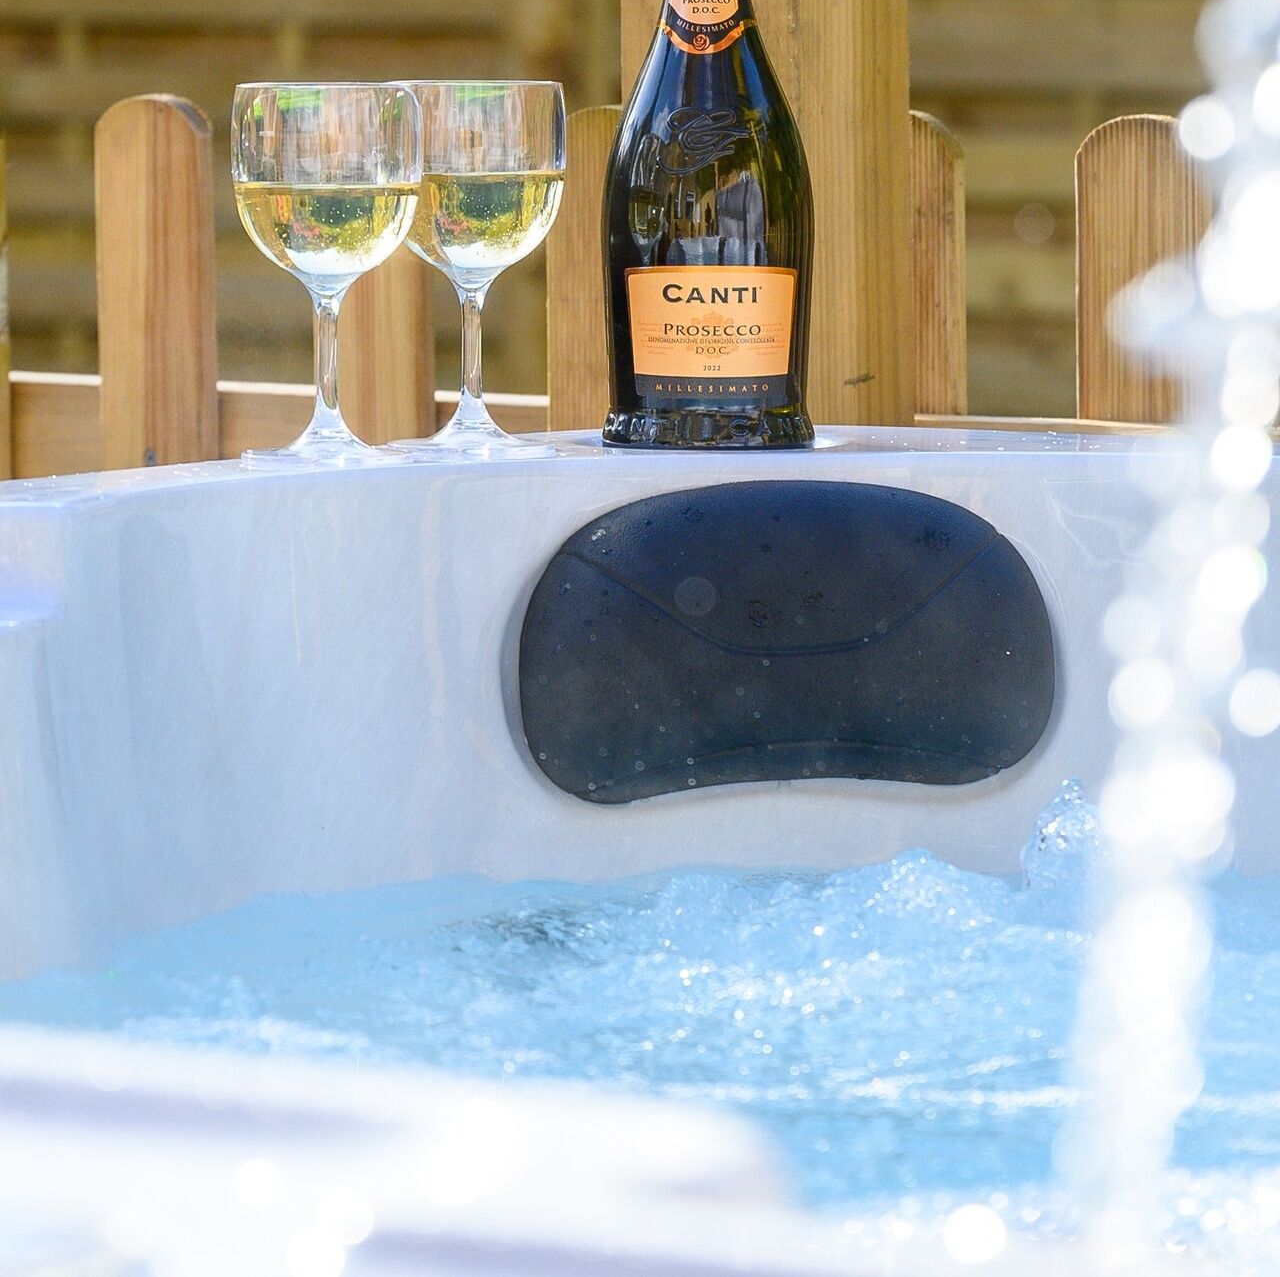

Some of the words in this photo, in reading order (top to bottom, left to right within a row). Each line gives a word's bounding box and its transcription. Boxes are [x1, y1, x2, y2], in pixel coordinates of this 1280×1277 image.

[692, 6, 721, 14] D.O.C.
[677, 19, 735, 33] MILLESIMATO
[662, 283, 758, 304] CANTI
[664, 323, 761, 337] PROSECCO
[695, 346, 730, 355] D.O.C.
[655, 383, 769, 392] MILLESIMATO
